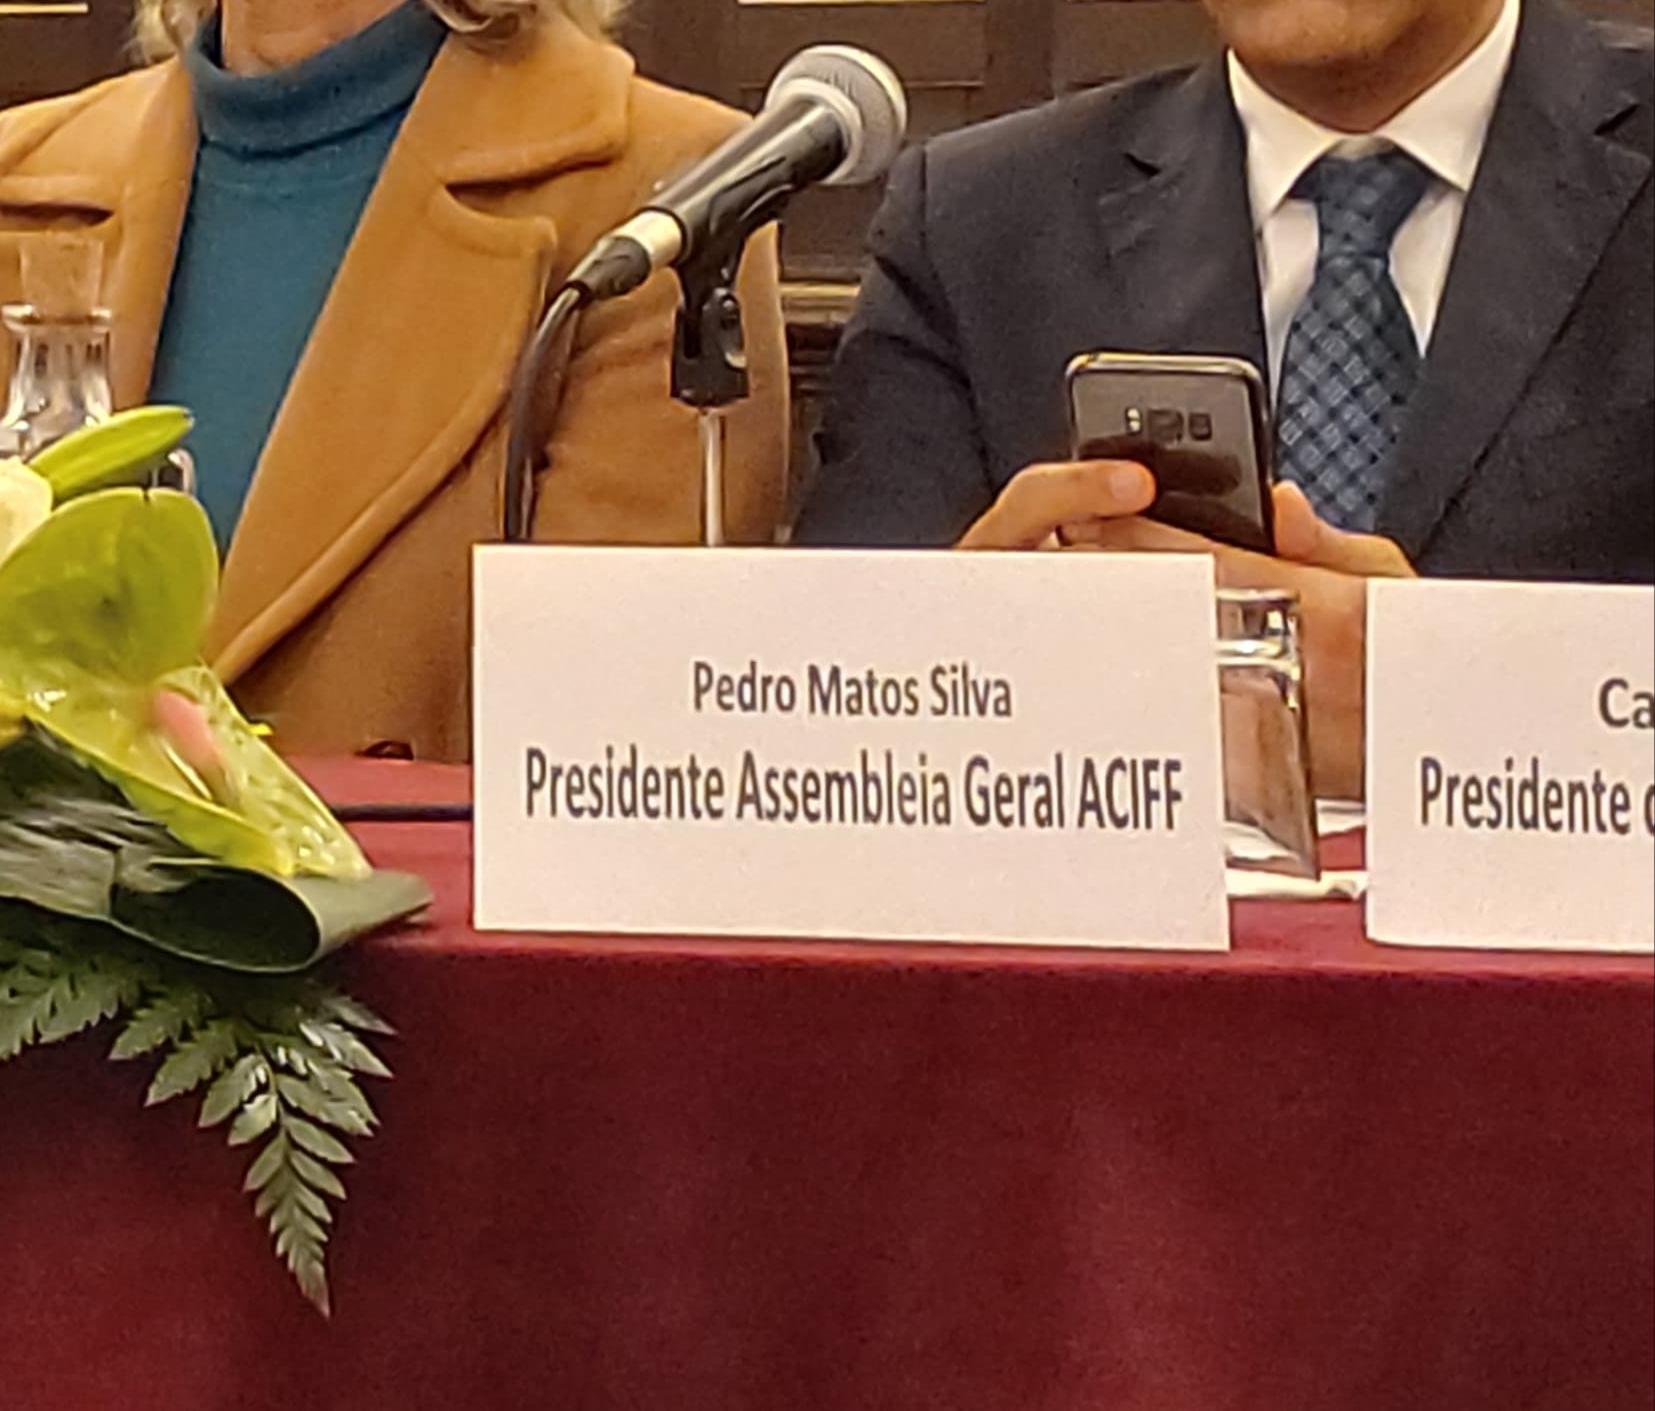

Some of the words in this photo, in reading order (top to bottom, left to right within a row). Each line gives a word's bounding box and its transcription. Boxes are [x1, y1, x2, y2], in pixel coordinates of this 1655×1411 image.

[694, 660, 796, 713] Pedro
[808, 664, 919, 717] Matos
[930, 664, 1012, 717] Silva
[526, 744, 724, 820] Presidente
[736, 749, 951, 826] Assembleia
[964, 752, 1065, 828] Geral
[1077, 757, 1182, 831] ACIFF
[1421, 756, 1631, 836] Presidente
